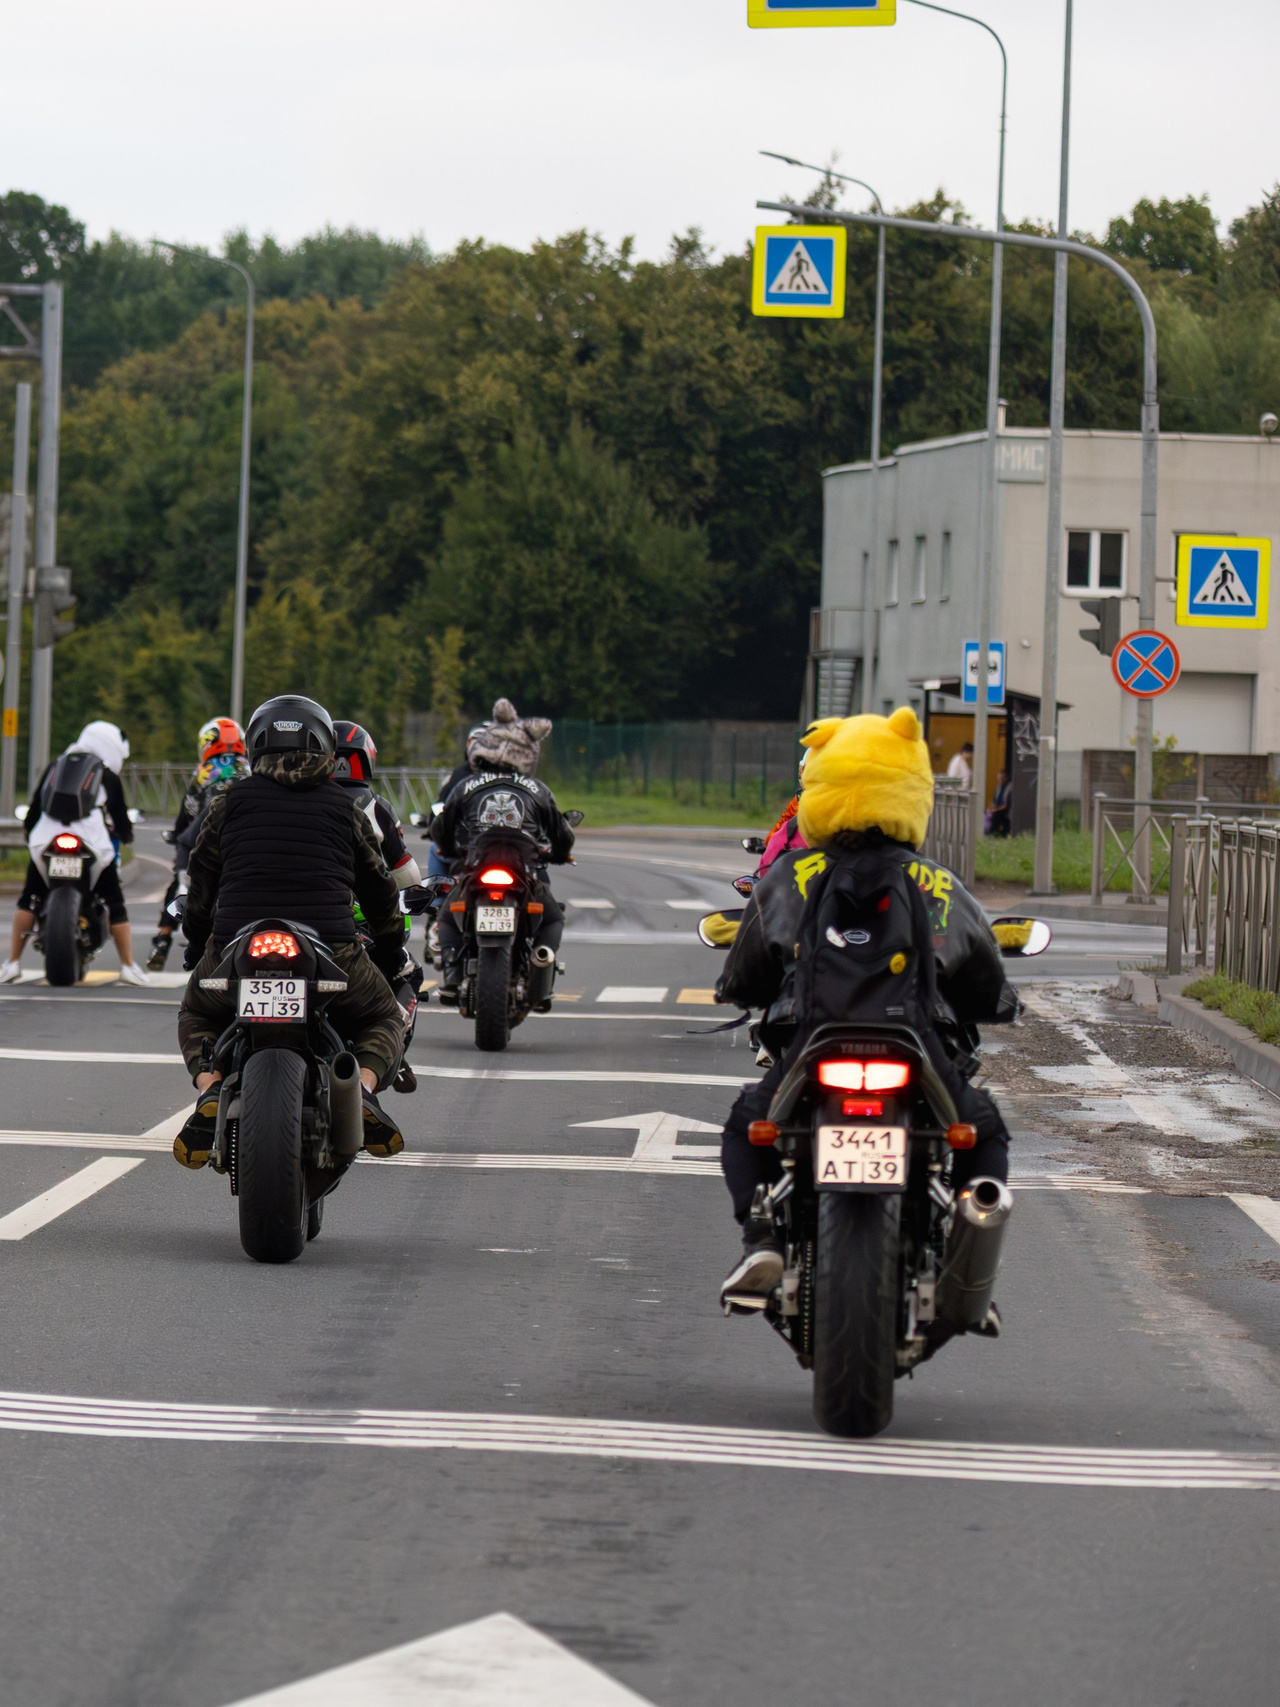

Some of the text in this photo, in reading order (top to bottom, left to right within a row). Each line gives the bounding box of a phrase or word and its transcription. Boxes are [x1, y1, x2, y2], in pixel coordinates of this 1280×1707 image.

[482, 908, 510, 917] 3283
[499, 921, 512, 930] 39
[249, 981, 296, 995] 3510
[242, 1001, 300, 1016] AT 39
[831, 1130, 891, 1150] 3441
[823, 1160, 897, 1180] AT 39
